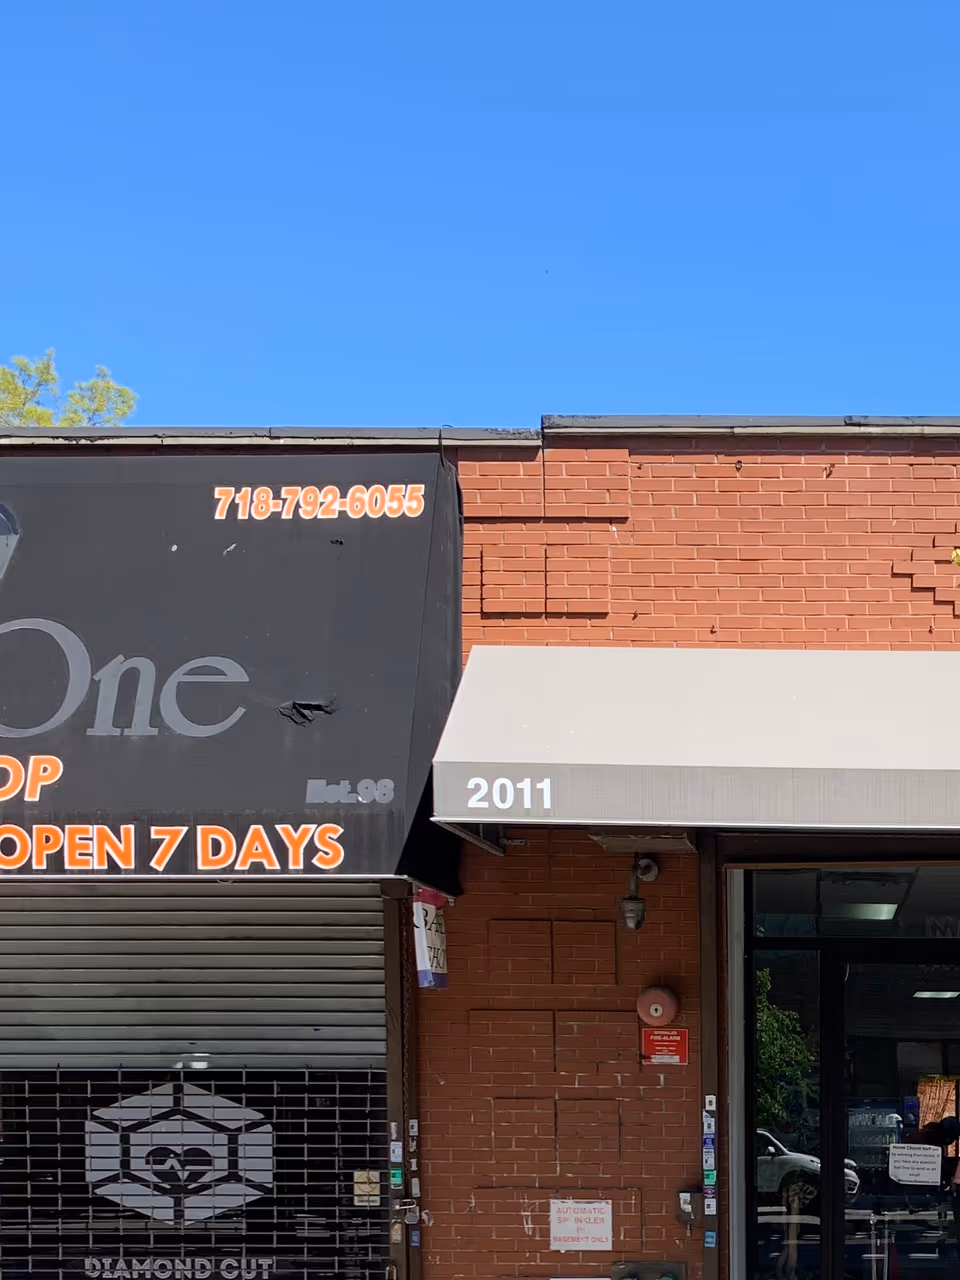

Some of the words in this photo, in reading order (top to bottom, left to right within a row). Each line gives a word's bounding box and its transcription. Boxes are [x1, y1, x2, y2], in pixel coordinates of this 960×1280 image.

[213, 484, 425, 520] 718-792-6055
[0, 617, 249, 738] One
[466, 777, 552, 809] 2011
[0, 824, 135, 870] OPEN
[150, 826, 189, 872] 7
[197, 823, 345, 871] DAYS
[556, 1207, 606, 1215] AUTOMATIC
[84, 1257, 213, 1279] DIAMOND
[219, 1257, 274, 1280] CUT
